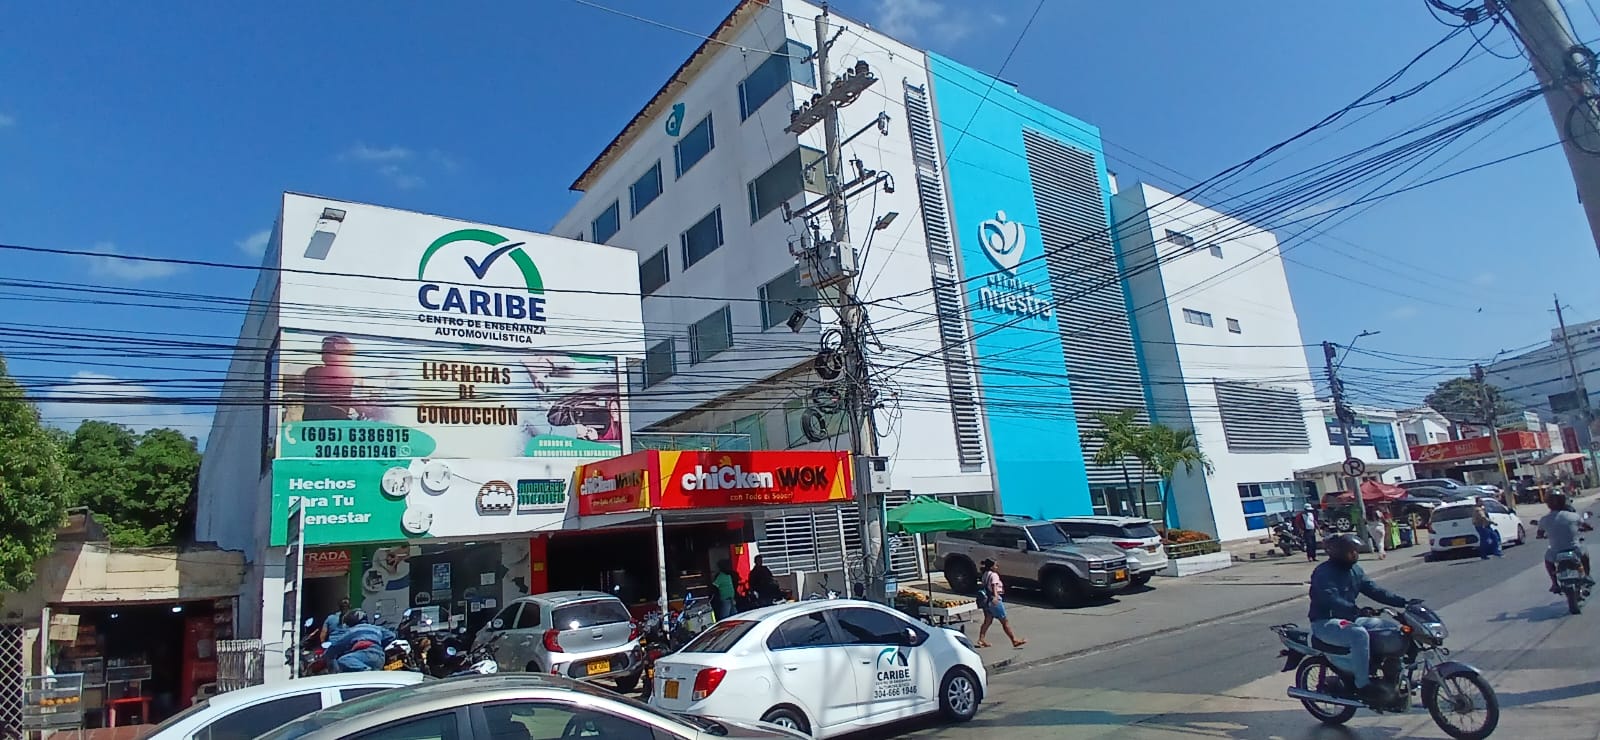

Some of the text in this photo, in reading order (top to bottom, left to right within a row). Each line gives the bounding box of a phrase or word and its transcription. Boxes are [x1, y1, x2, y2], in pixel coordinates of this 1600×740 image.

[418, 284, 547, 322] CARIBE
[418, 314, 546, 335] CENTRO DE ENSEÑANZA
[422, 361, 511, 384] LICENCIAS
[459, 384, 475, 399] DE
[417, 404, 518, 425] CONDUCCIÓN
[302, 427, 409, 442] (605) 6386915
[315, 445, 396, 458] 3046661946
[289, 478, 356, 490] Hechos
[776, 465, 829, 490] WOK
[332, 495, 354, 506] Tu
[305, 512, 371, 525] enestar
[877, 669, 910, 681] CARIBE
